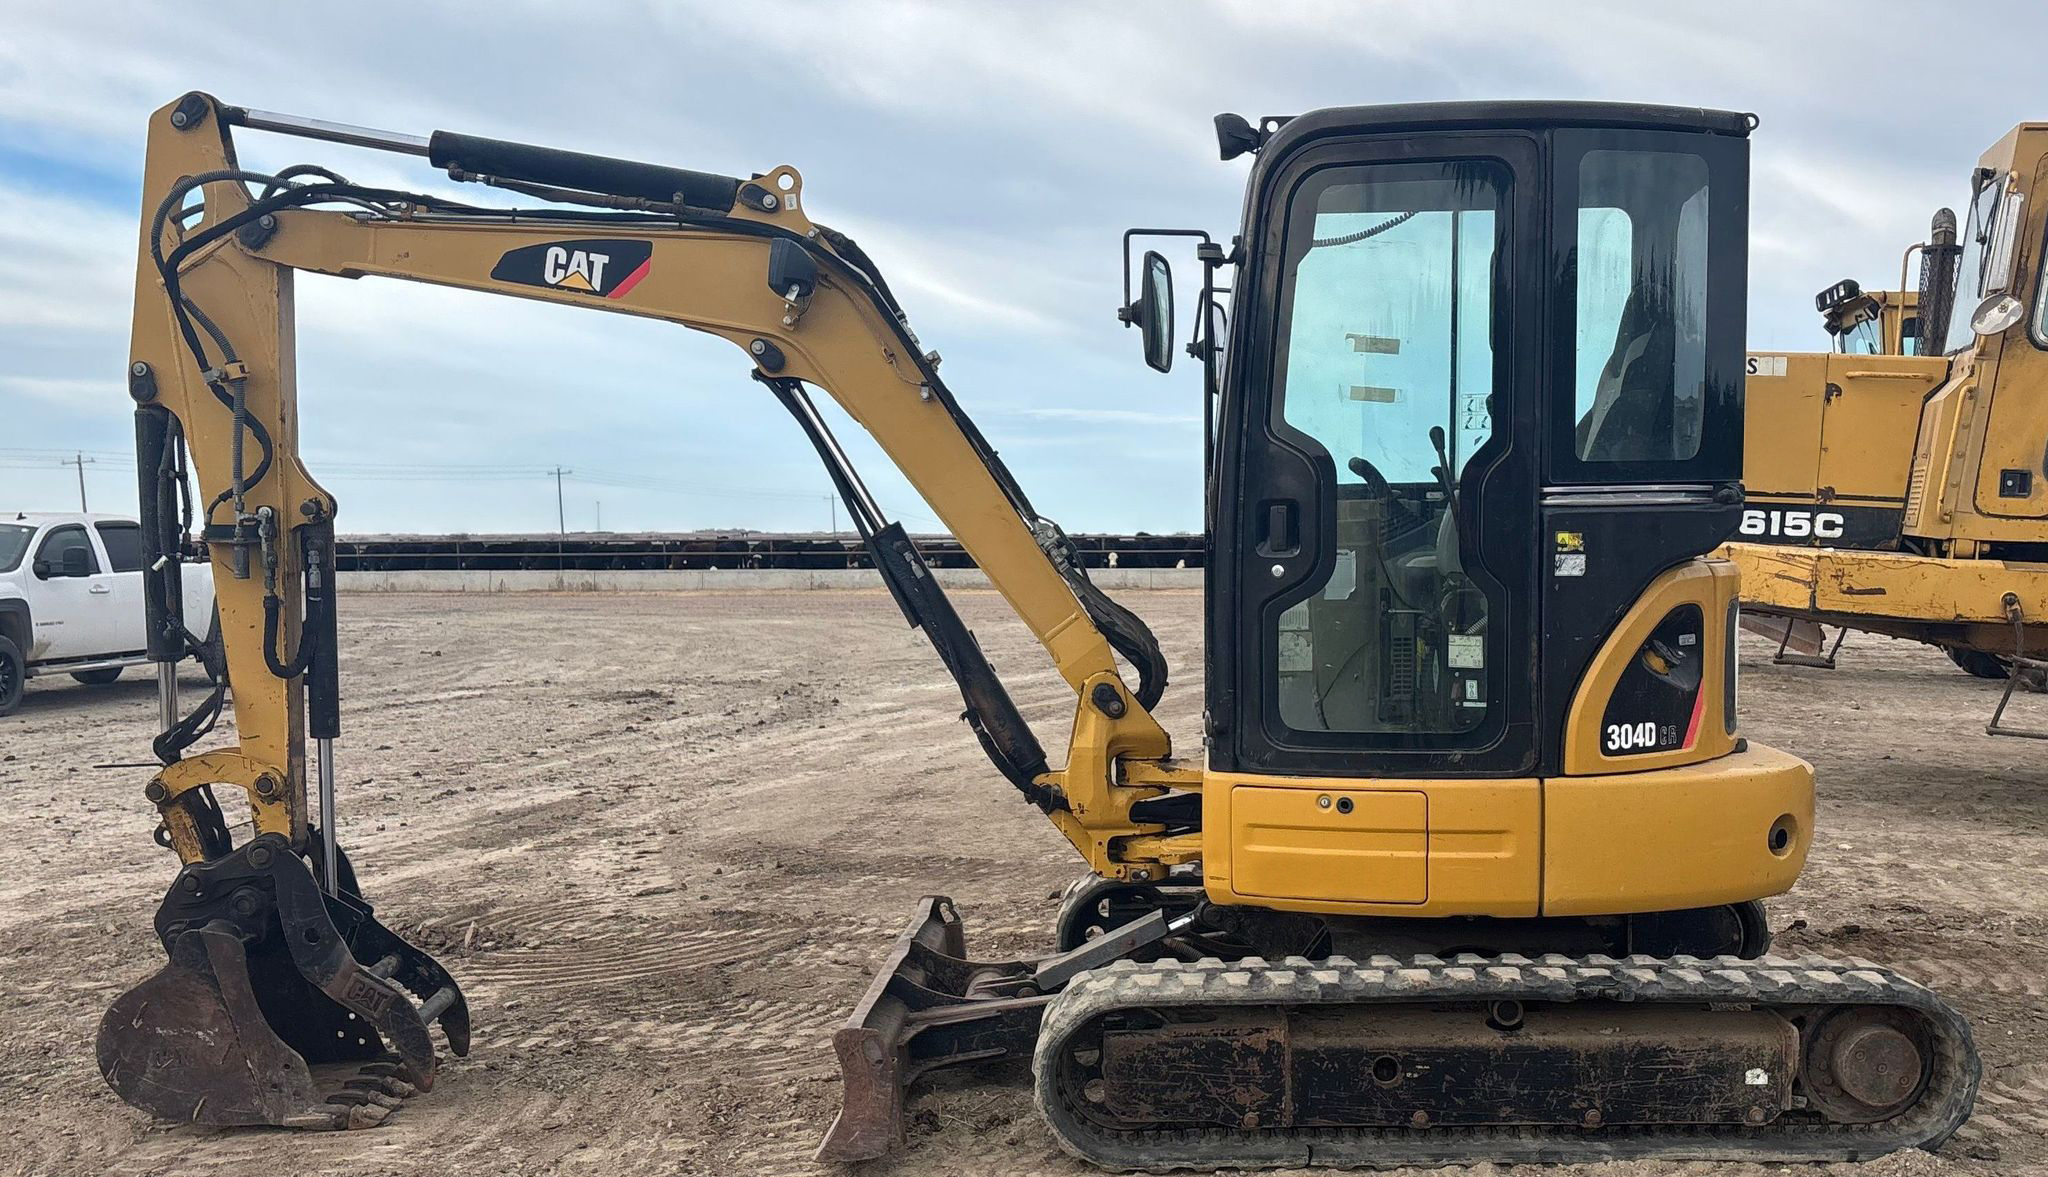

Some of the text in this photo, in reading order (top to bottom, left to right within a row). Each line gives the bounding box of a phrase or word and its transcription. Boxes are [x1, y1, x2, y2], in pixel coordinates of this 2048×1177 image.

[544, 246, 610, 292] CAT
[1739, 510, 1844, 539] 615C
[1607, 722, 1677, 750] 304D CR
[347, 980, 390, 1013] CAT
